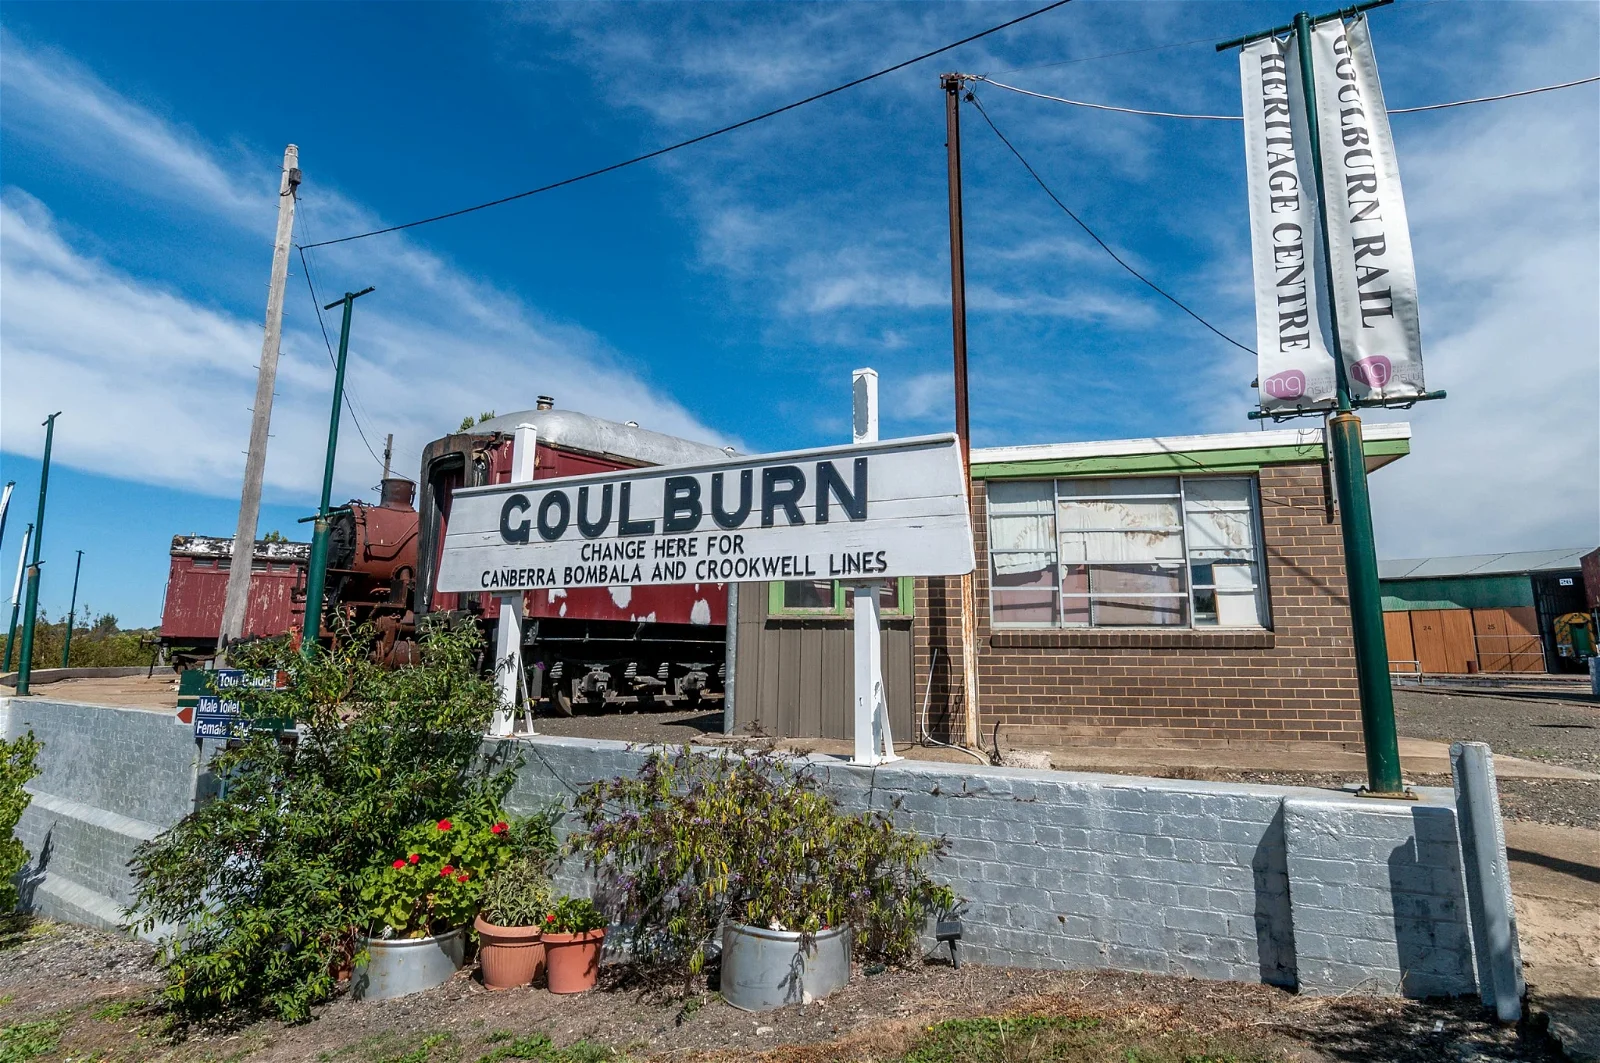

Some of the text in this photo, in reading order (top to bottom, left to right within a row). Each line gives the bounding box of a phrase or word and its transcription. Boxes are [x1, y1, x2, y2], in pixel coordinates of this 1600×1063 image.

[1260, 53, 1311, 353] HERITAGE CENTRE
[1352, 231, 1394, 329] RAIL
[500, 457, 868, 545] GOULBURN
[581, 534, 745, 562] CHANGE HERE FOR
[481, 550, 888, 588] CANBERRA BOMBALA AND CROOKWELL LINES
[200, 699, 240, 714] Male Toilet
[197, 720, 227, 735] Female
